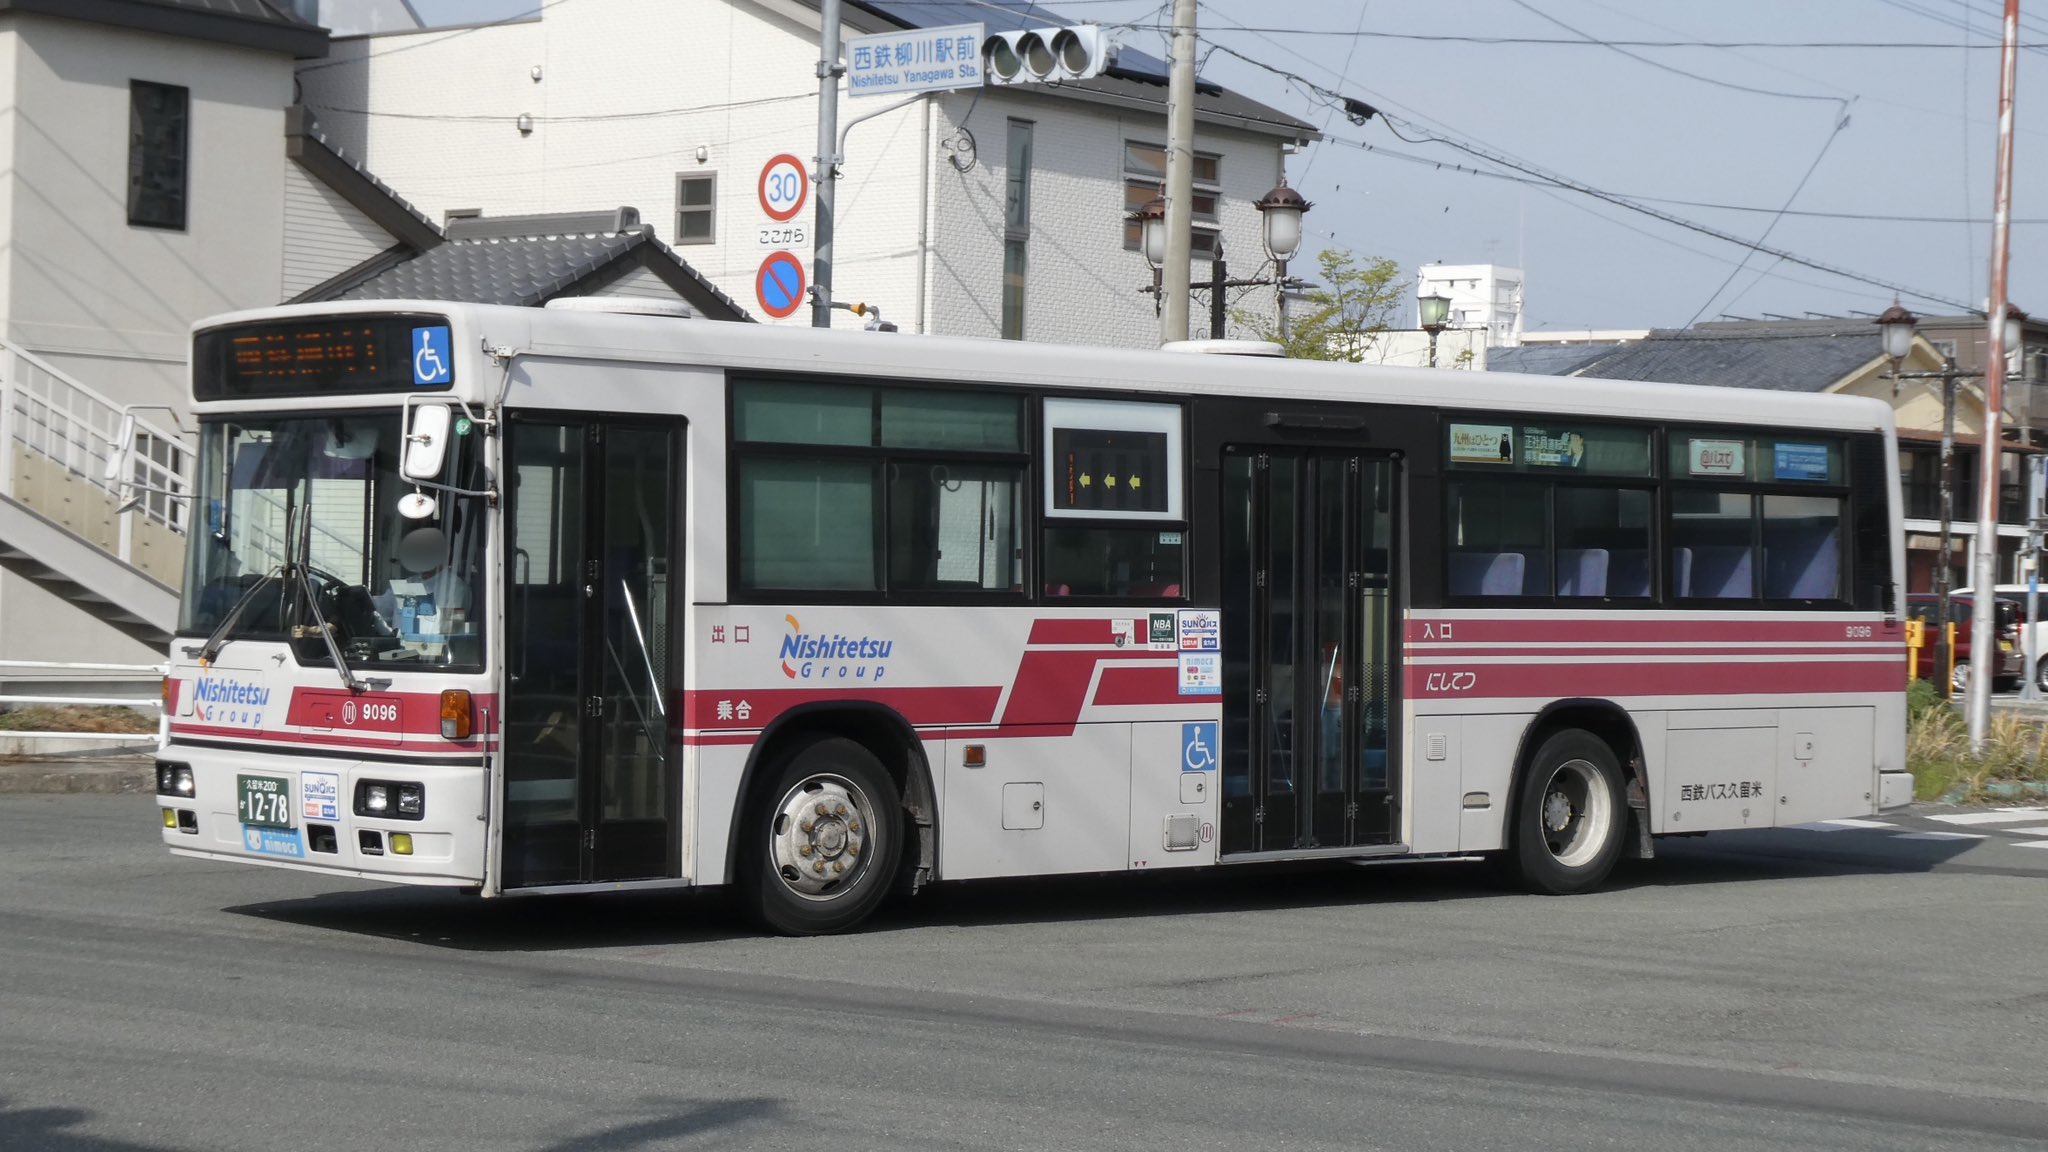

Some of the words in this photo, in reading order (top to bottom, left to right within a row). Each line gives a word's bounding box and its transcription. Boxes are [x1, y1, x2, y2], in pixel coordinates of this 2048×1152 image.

[854, 35, 976, 71] 西鉄柳川駅前
[851, 69, 899, 88] Nishitetsu
[903, 68, 954, 84] Yanagawa
[959, 64, 979, 79] Sta.
[769, 173, 797, 202] 30
[759, 228, 805, 245] ここから
[711, 625, 750, 644] 出口
[1153, 619, 1171, 629] NBA
[1423, 622, 1452, 639] 入口
[1845, 625, 1872, 638] 9096
[779, 633, 893, 659] Nishitetsu
[801, 662, 885, 681] Group
[1425, 671, 1476, 691] にしてつ
[194, 677, 270, 706] Nishitetsu
[206, 705, 262, 728] Group
[362, 703, 397, 722] 9096
[717, 699, 752, 720] 乗合
[1681, 780, 1762, 802] 西鉄バス久留米
[247, 791, 288, 823] 12-78
